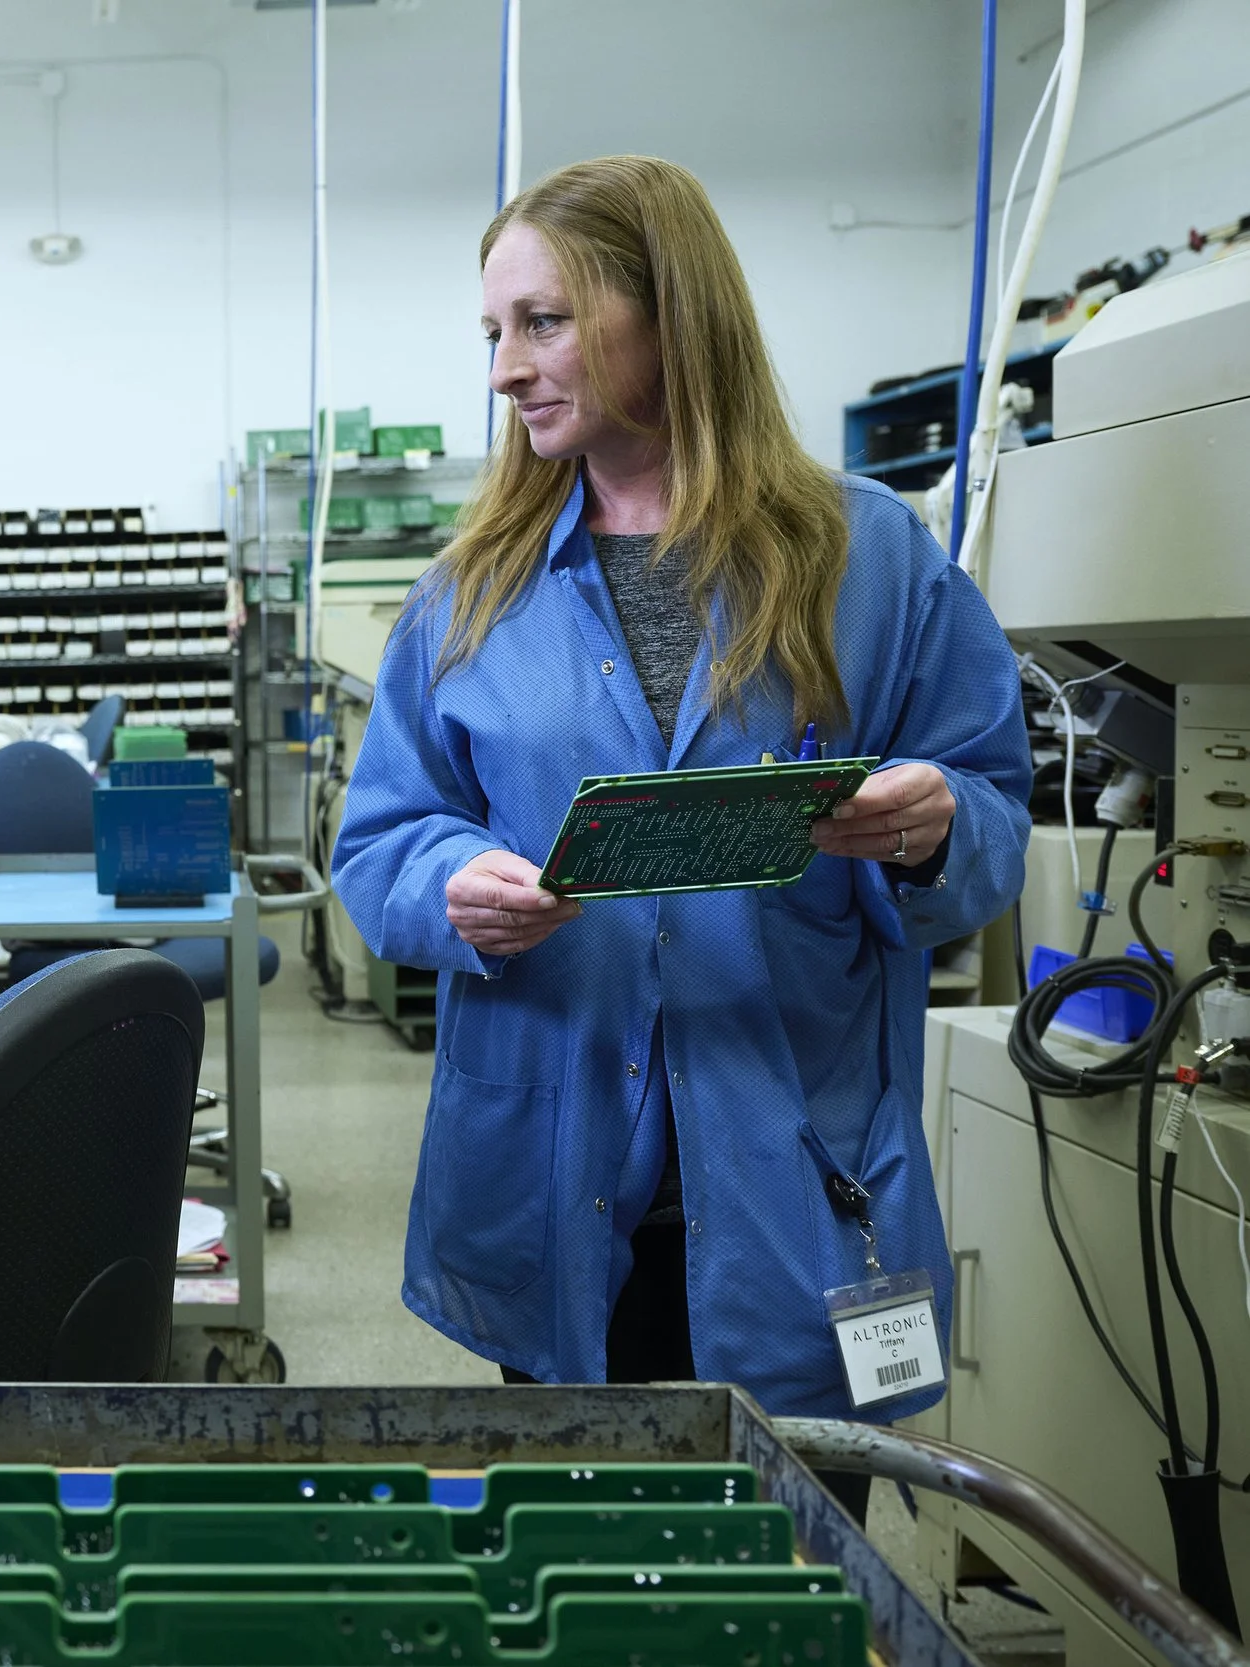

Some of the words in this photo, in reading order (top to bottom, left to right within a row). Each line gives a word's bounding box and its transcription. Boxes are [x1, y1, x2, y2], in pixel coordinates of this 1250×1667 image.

[853, 1312, 928, 1343] ALTRONIC
[879, 1336, 905, 1349] Tiffany
[891, 1349, 898, 1358] C
